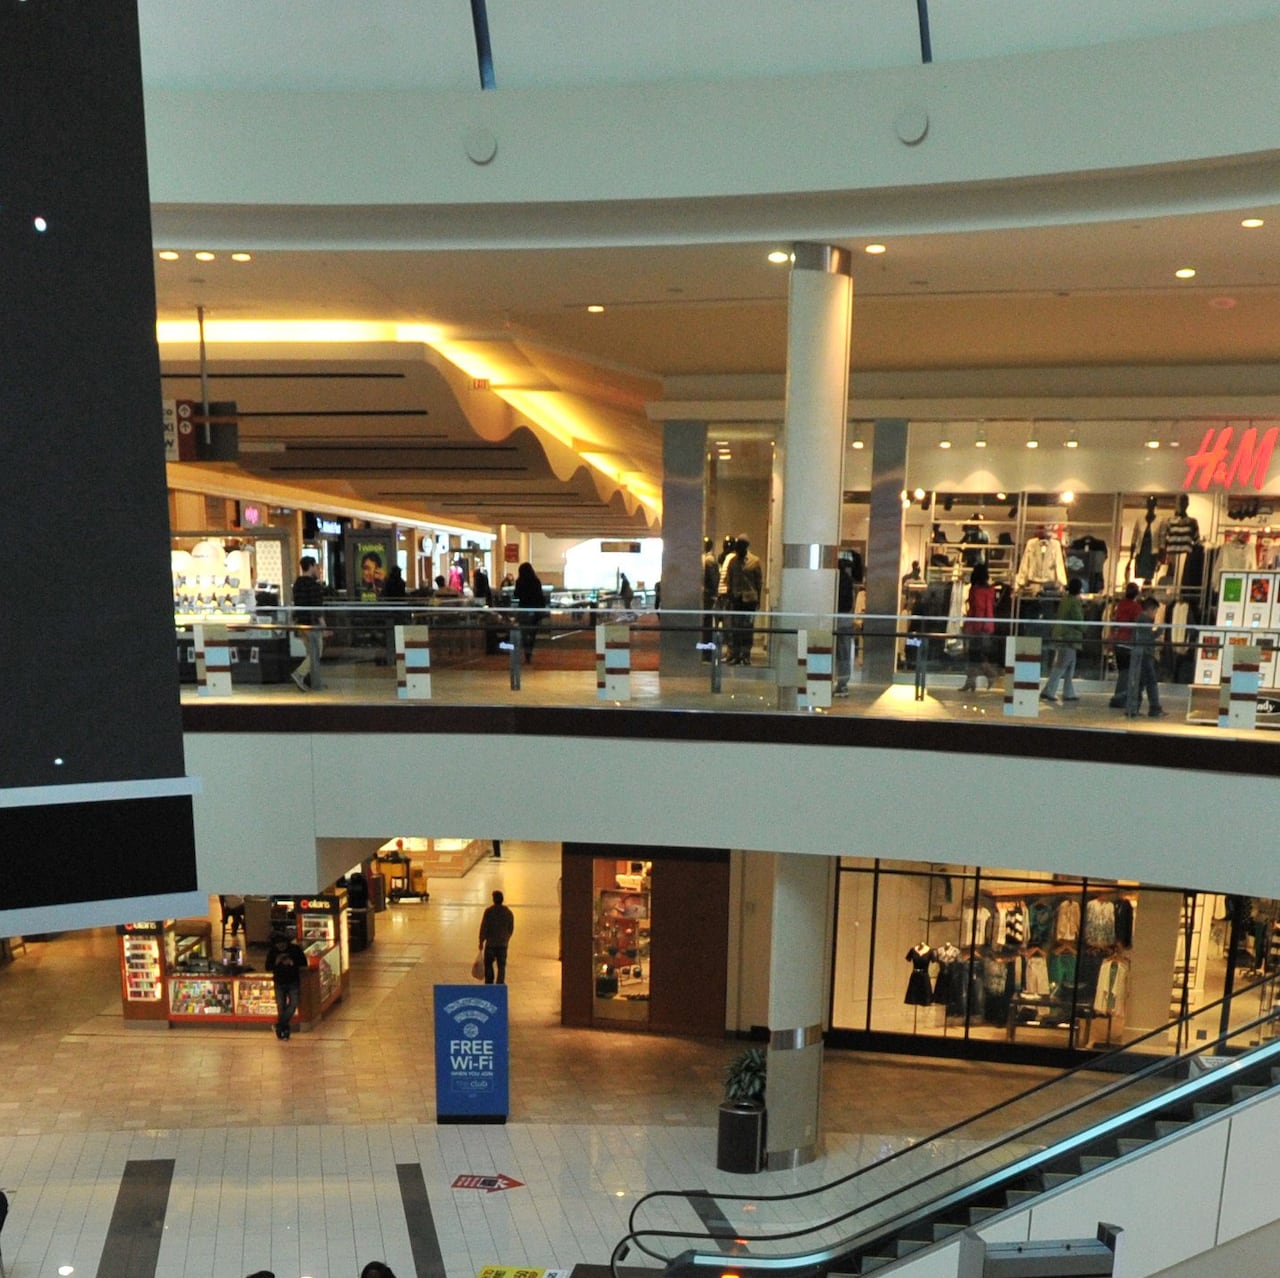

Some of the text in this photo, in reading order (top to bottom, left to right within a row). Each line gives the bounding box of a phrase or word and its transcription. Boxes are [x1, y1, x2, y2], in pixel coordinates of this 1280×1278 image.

[1183, 426, 1280, 492] H&M
[450, 1039, 494, 1055] FREE
[450, 1055, 494, 1071] Wi-Fi
